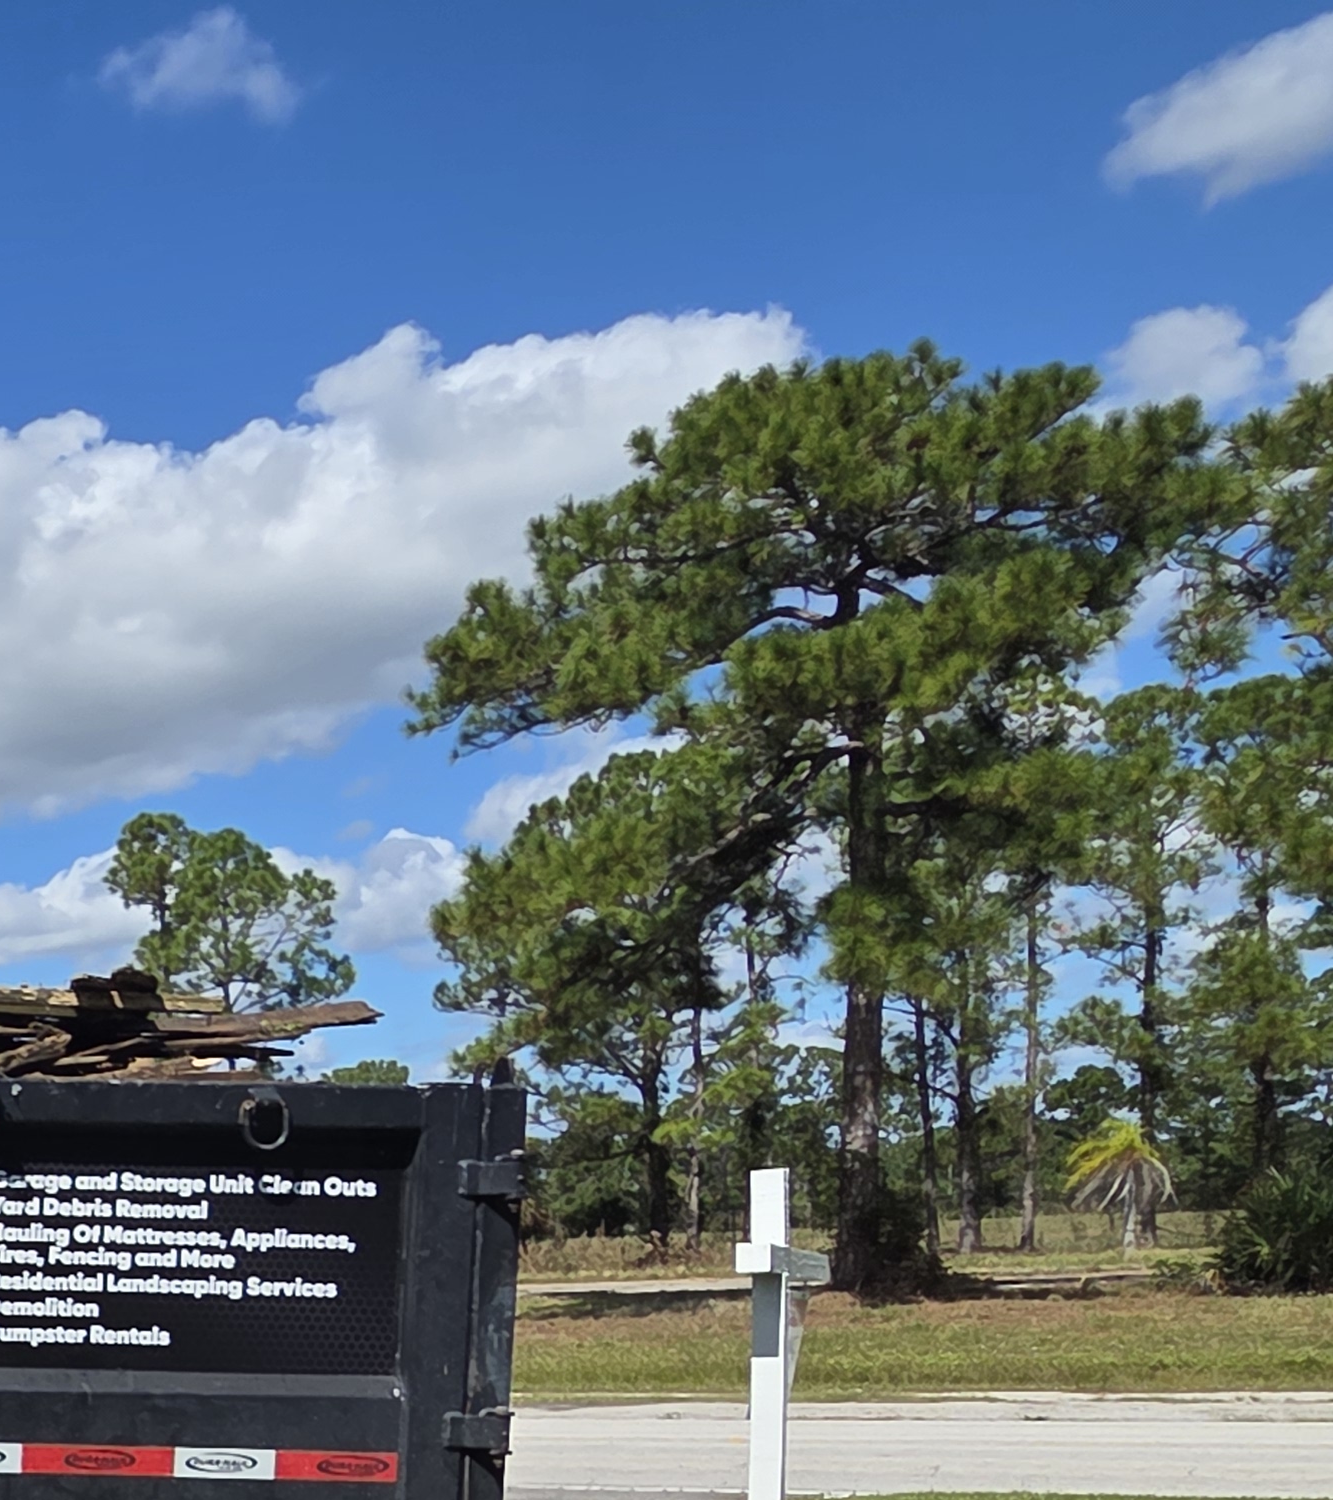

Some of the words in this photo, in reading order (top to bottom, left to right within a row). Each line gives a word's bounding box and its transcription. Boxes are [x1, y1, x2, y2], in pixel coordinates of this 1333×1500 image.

[75, 1172, 118, 1190] and
[120, 1172, 207, 1197] Storage
[209, 1174, 254, 1194] Unit
[258, 1174, 321, 1196] Clean
[323, 1177, 377, 1198] Outs
[42, 1197, 113, 1217] Debris
[115, 1199, 209, 1220] Removal
[73, 1224, 101, 1244] Of
[103, 1225, 227, 1249] Mattresses,
[230, 1227, 356, 1253] Appliances,
[48, 1246, 132, 1271] Fencing
[134, 1249, 177, 1268] and
[180, 1249, 236, 1270] More
[107, 1274, 243, 1300] Landscaping
[246, 1276, 338, 1299] Services
[89, 1325, 171, 1346] Rentals
